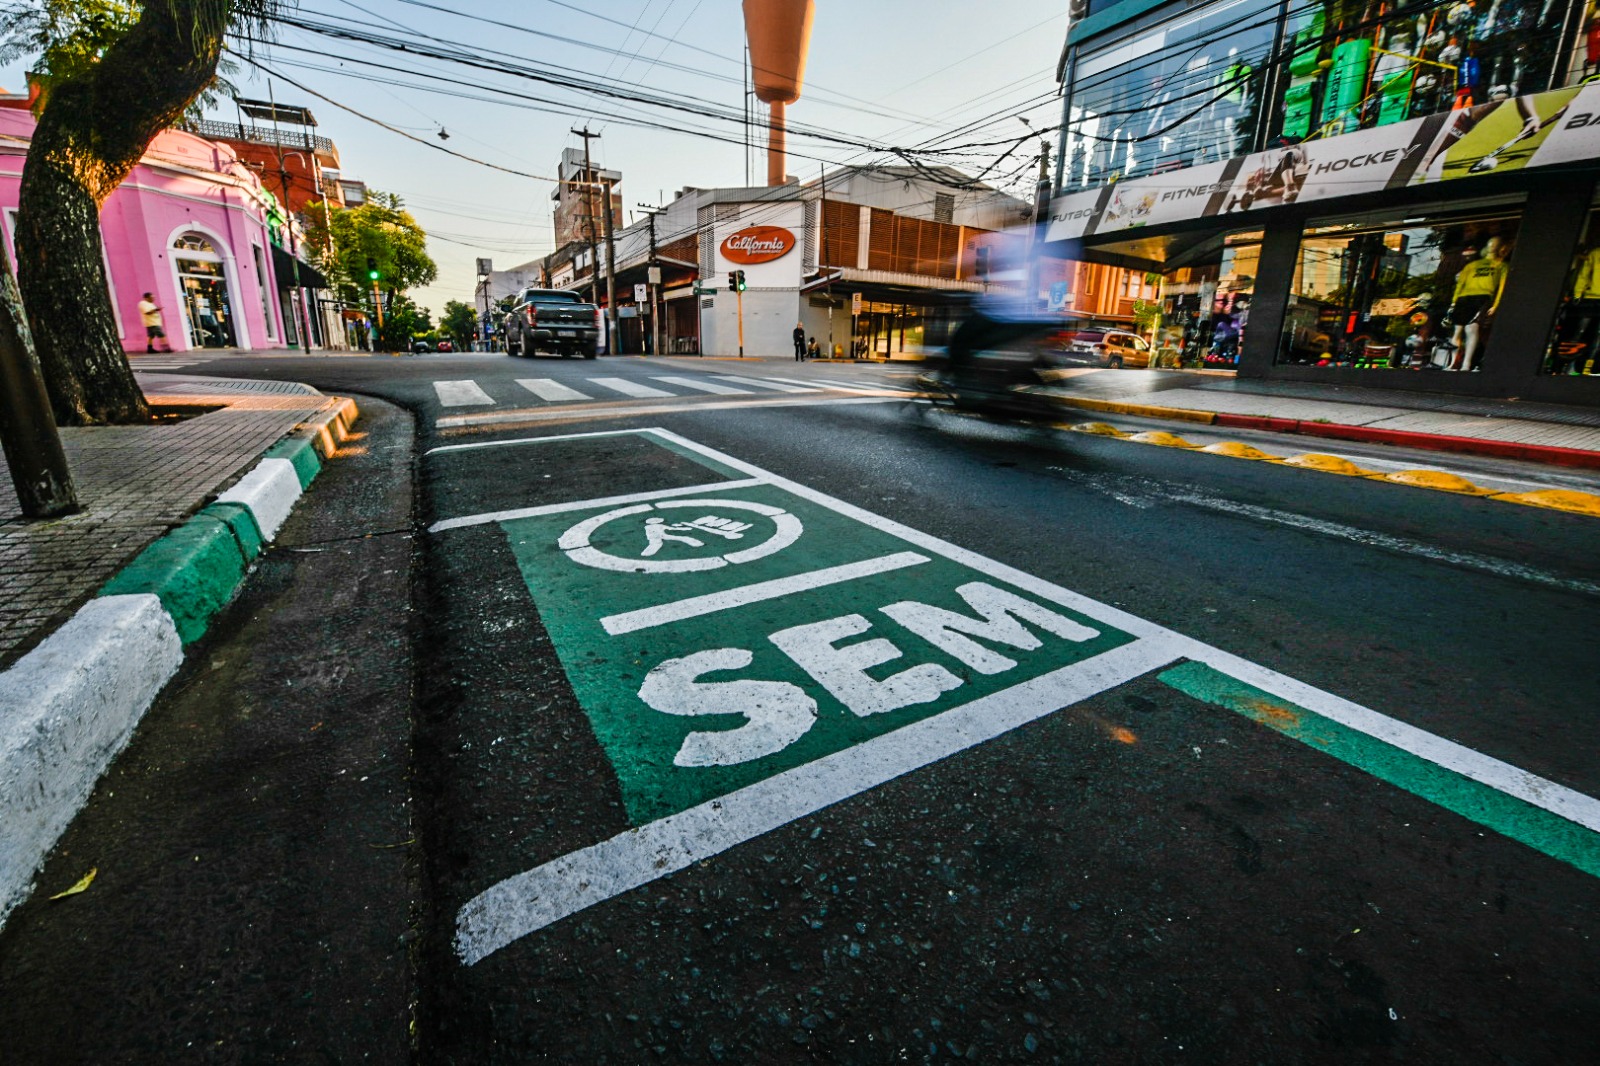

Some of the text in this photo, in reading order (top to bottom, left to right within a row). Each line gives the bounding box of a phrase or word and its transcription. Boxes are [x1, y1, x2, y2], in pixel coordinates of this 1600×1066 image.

[1314, 143, 1422, 175] HOCKEY
[1161, 179, 1234, 202] FITNESS
[727, 235, 785, 256] California
[637, 581, 1100, 768] SEM
